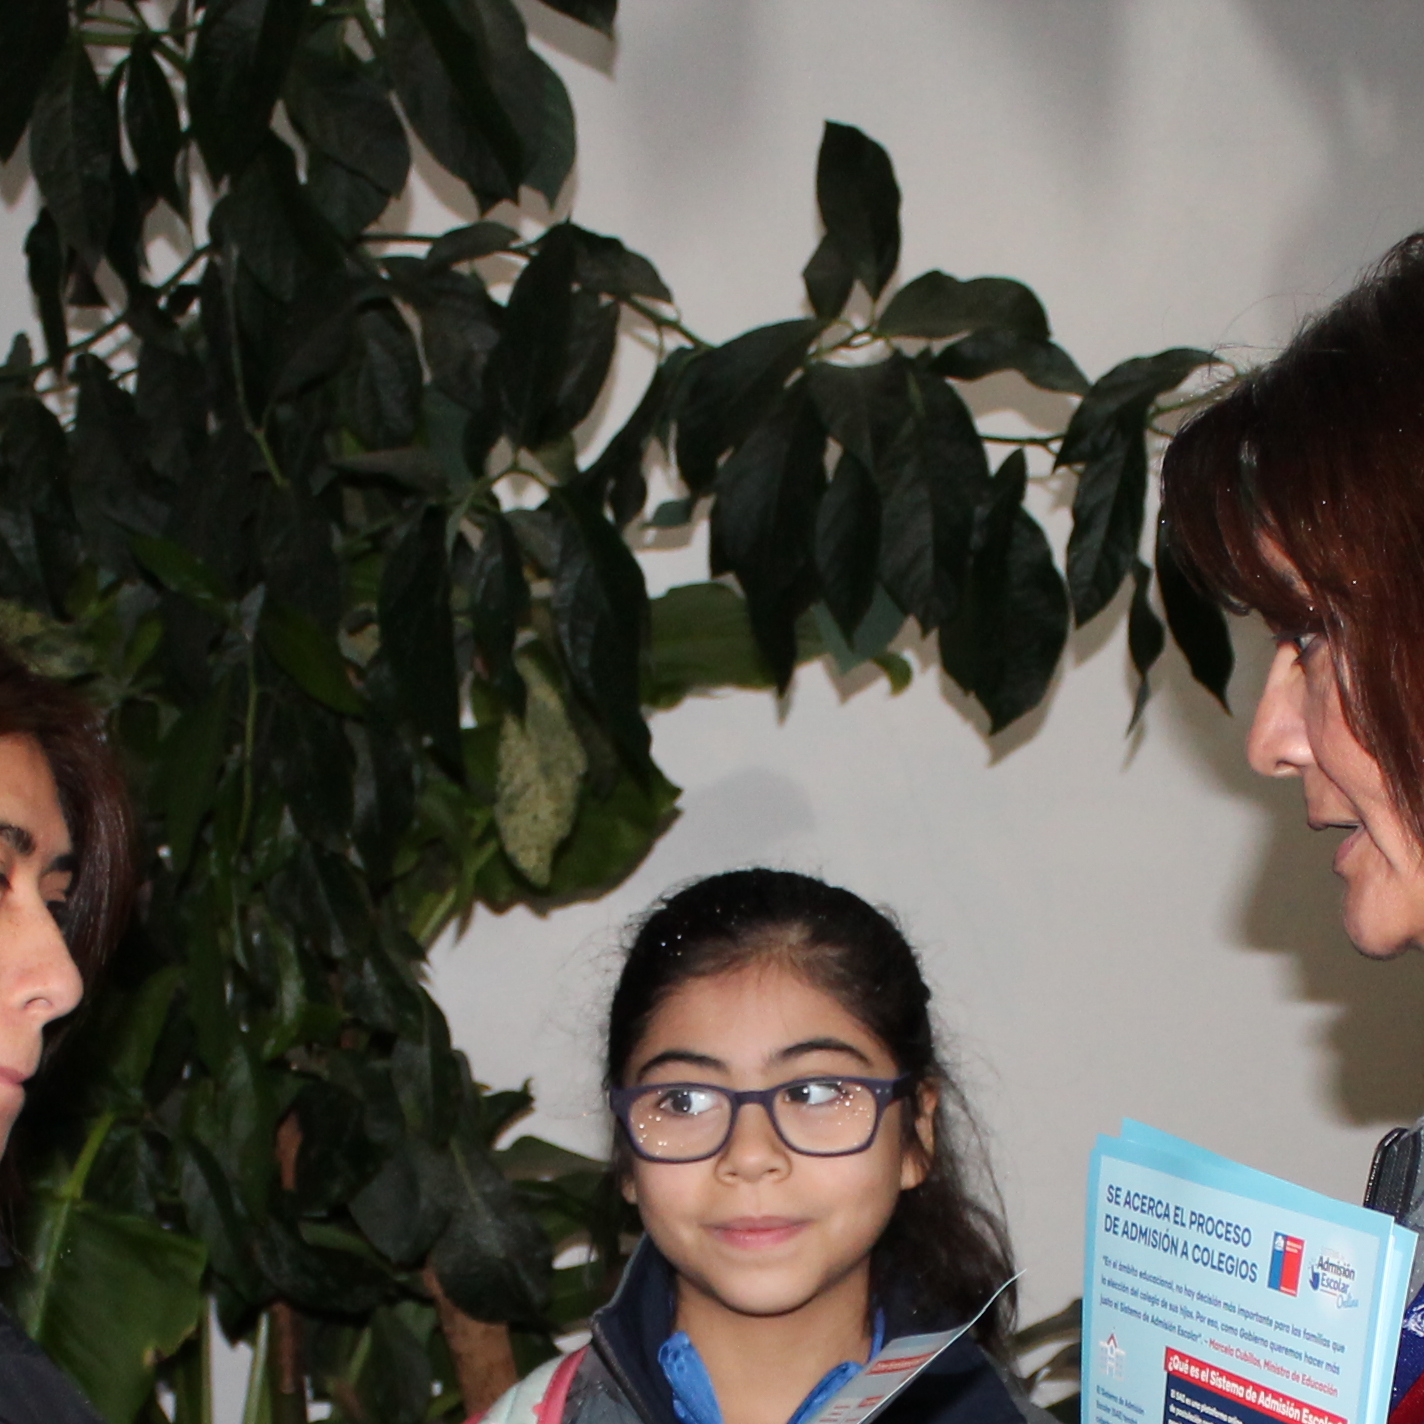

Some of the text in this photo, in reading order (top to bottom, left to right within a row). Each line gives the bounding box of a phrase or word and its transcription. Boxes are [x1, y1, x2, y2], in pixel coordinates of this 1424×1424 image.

[1106, 1185, 1252, 1247] SE ACERCA EL PROCESO
[1104, 1215, 1120, 1234] DE
[1121, 1221, 1178, 1254] ADMISIÓN
[1180, 1241, 1189, 1258] A
[1192, 1245, 1258, 1282] COLEGIOS
[1317, 1255, 1355, 1281] Admisión
[1320, 1272, 1349, 1294] Escolar
[1168, 1355, 1189, 1373] ¿Qué
[1190, 1366, 1199, 1377] es
[1200, 1368, 1209, 1381] el
[1209, 1370, 1244, 1396] Sistema
[1246, 1386, 1257, 1401] de
[1257, 1390, 1301, 1420] Admisión
